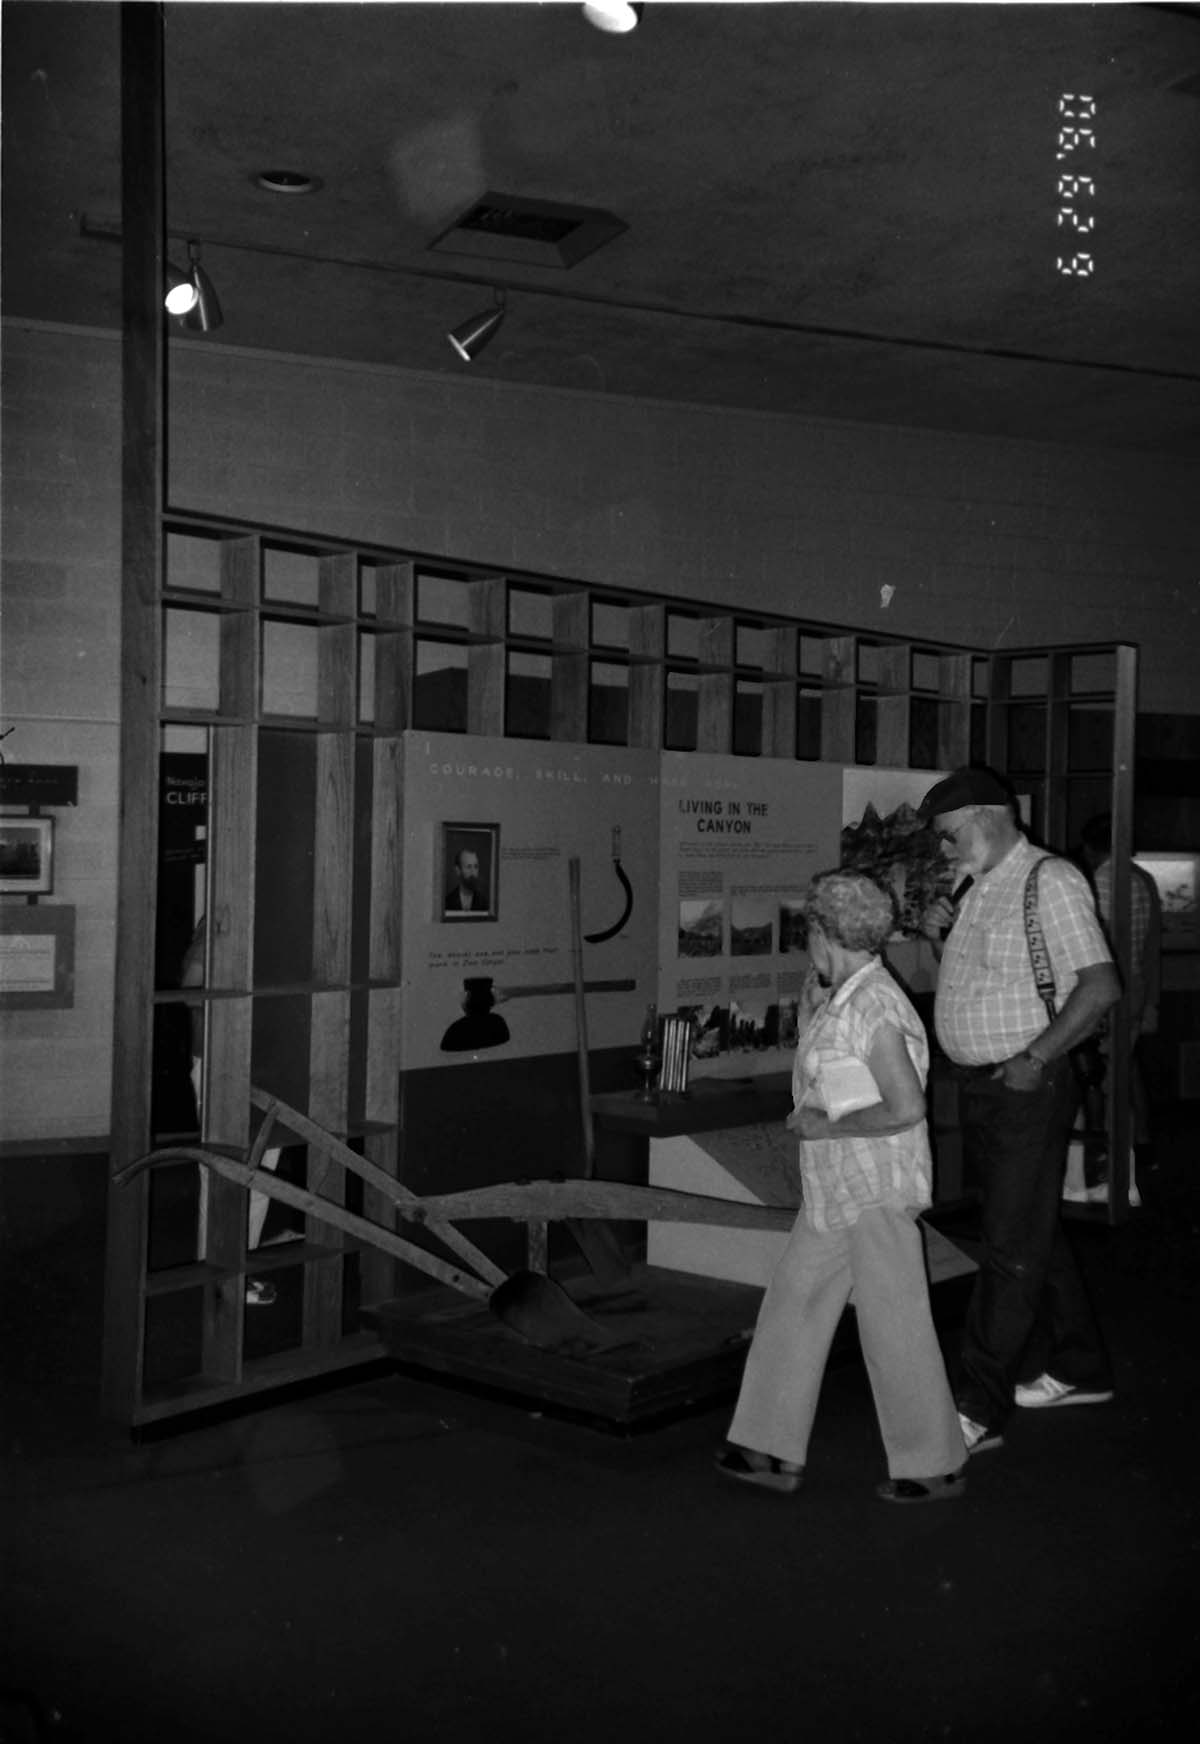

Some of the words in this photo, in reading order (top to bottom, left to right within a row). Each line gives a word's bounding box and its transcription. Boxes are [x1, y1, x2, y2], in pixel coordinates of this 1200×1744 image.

[601, 772, 633, 786] AND
[166, 791, 207, 805] CLIFF
[678, 799, 723, 816] LIVING
[728, 801, 741, 816] IN
[746, 802, 769, 817] THE
[696, 819, 752, 834] CANYON
